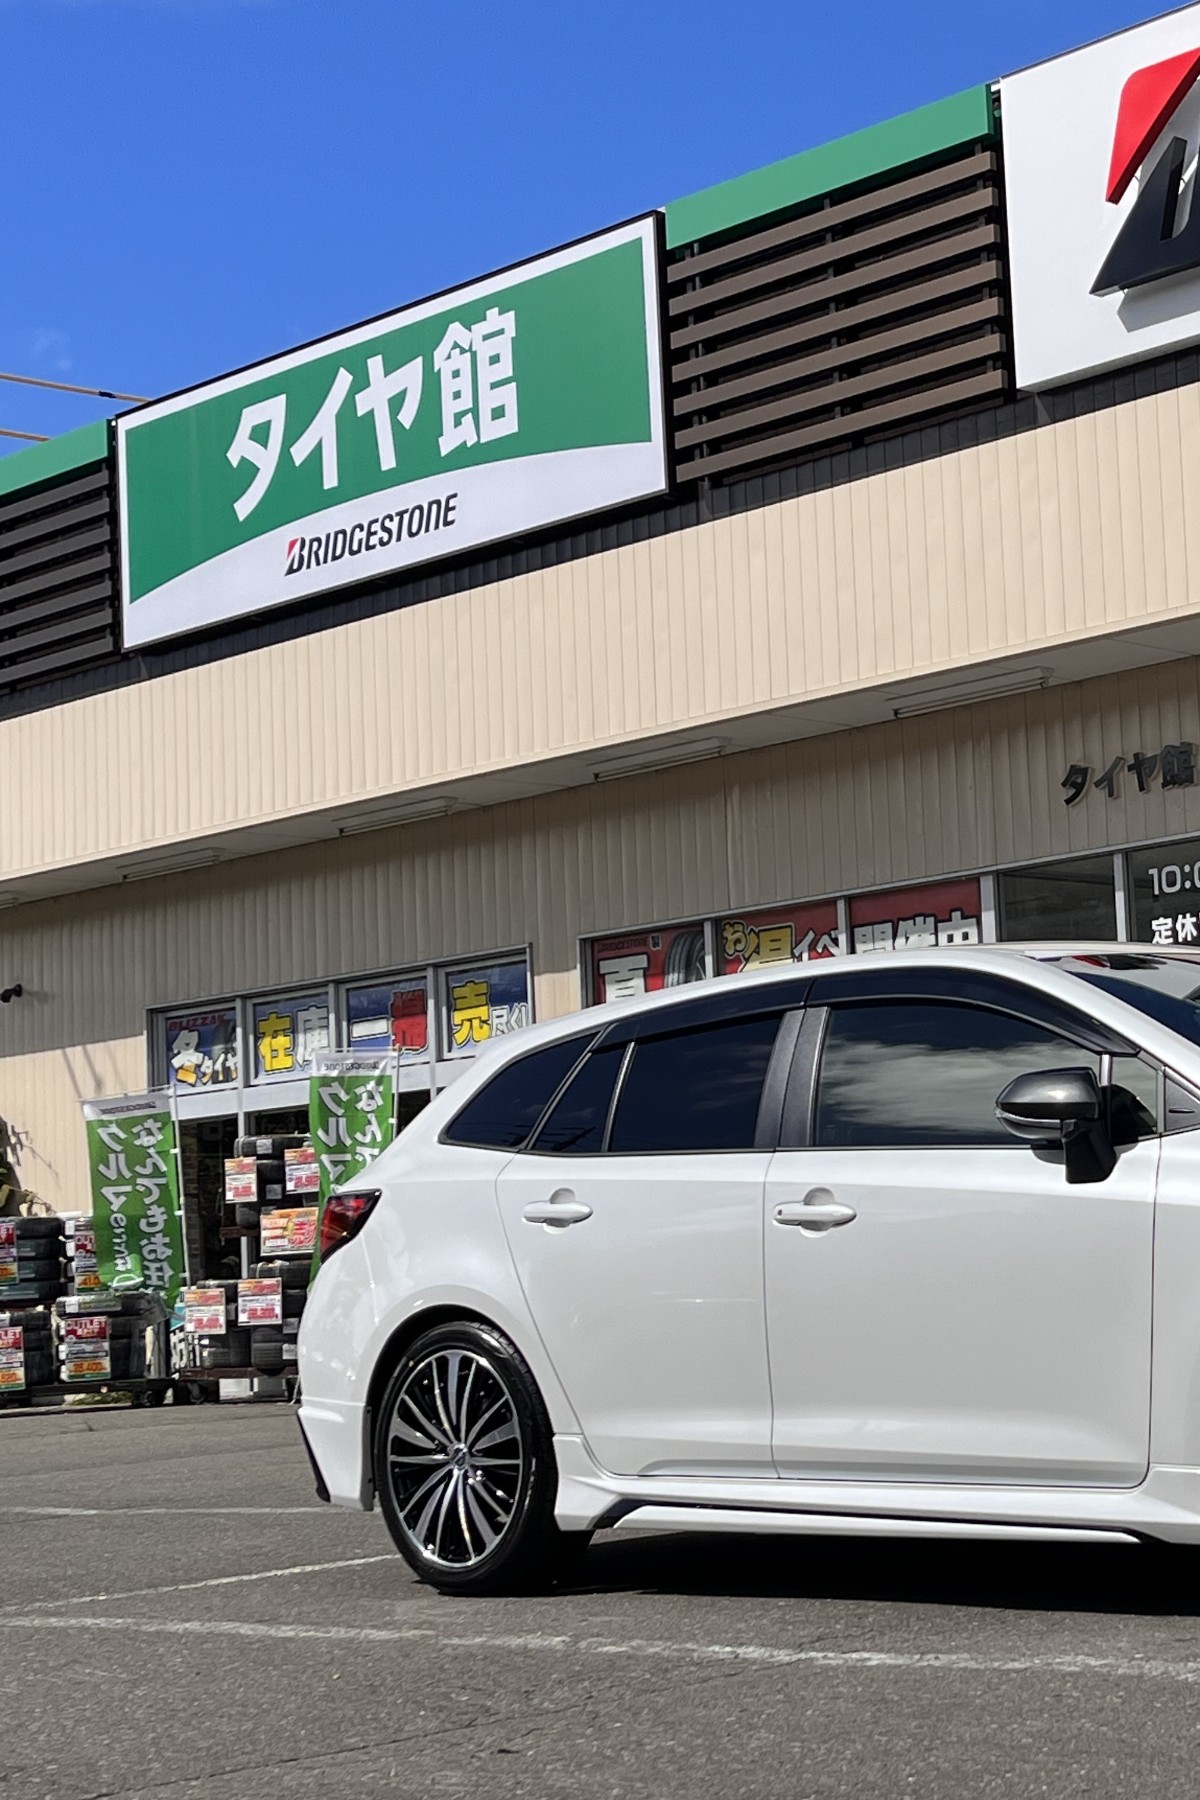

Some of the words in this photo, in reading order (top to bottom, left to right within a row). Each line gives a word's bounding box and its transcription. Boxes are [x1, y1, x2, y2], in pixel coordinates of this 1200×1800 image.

[226, 307, 518, 521] タイヤ館
[285, 492, 458, 576] BRIDGESTONE
[1061, 741, 1198, 807] タイヤ館
